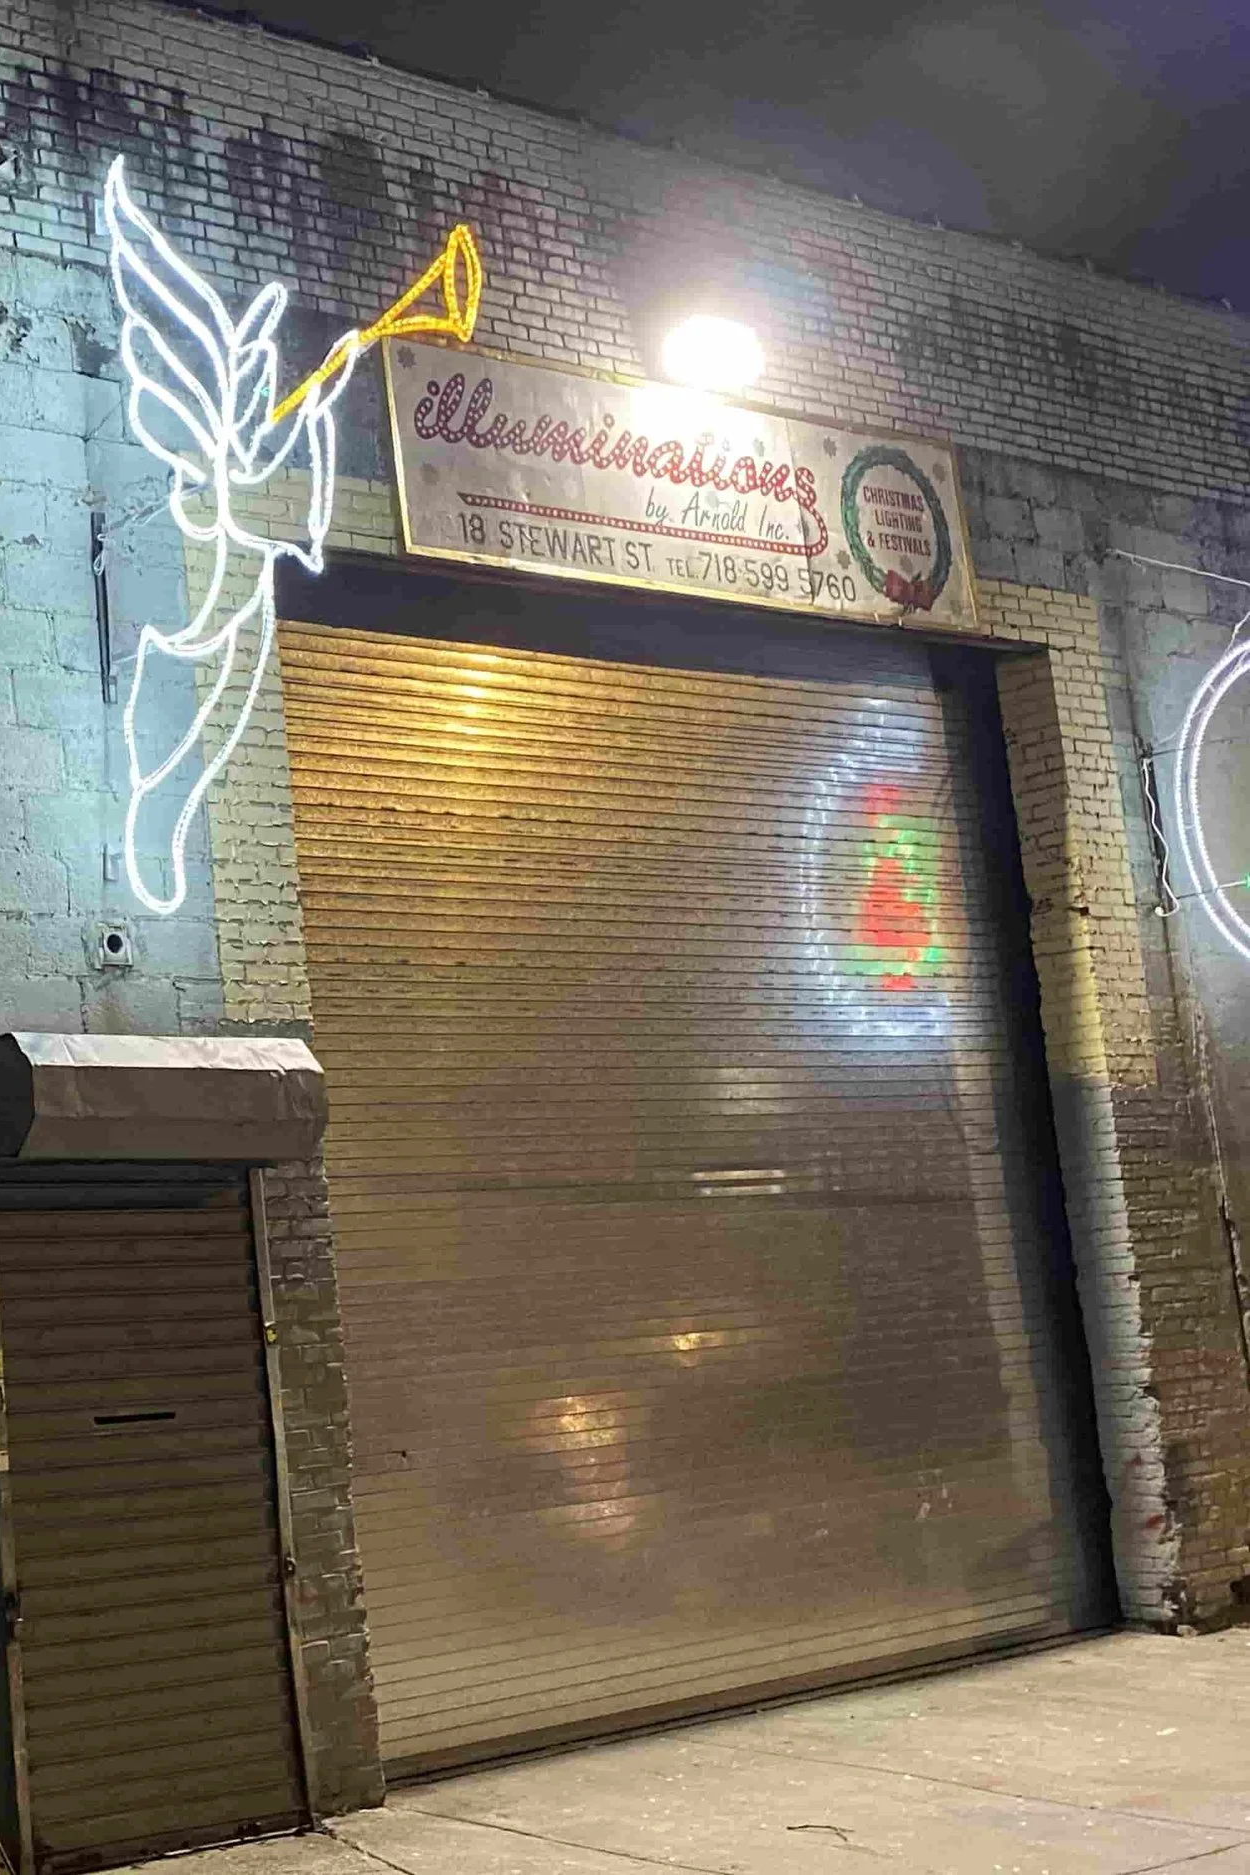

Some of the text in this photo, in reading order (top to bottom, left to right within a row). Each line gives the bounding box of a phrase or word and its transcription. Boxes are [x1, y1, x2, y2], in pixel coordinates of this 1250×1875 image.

[863, 486, 925, 513] CHRISTMAS
[681, 491, 747, 534] Arnold
[758, 505, 790, 542] Inc.
[875, 508, 923, 534] LIGHTING
[457, 511, 487, 546] 18
[499, 519, 616, 567] STEWART
[878, 532, 931, 557] FESTIVALS
